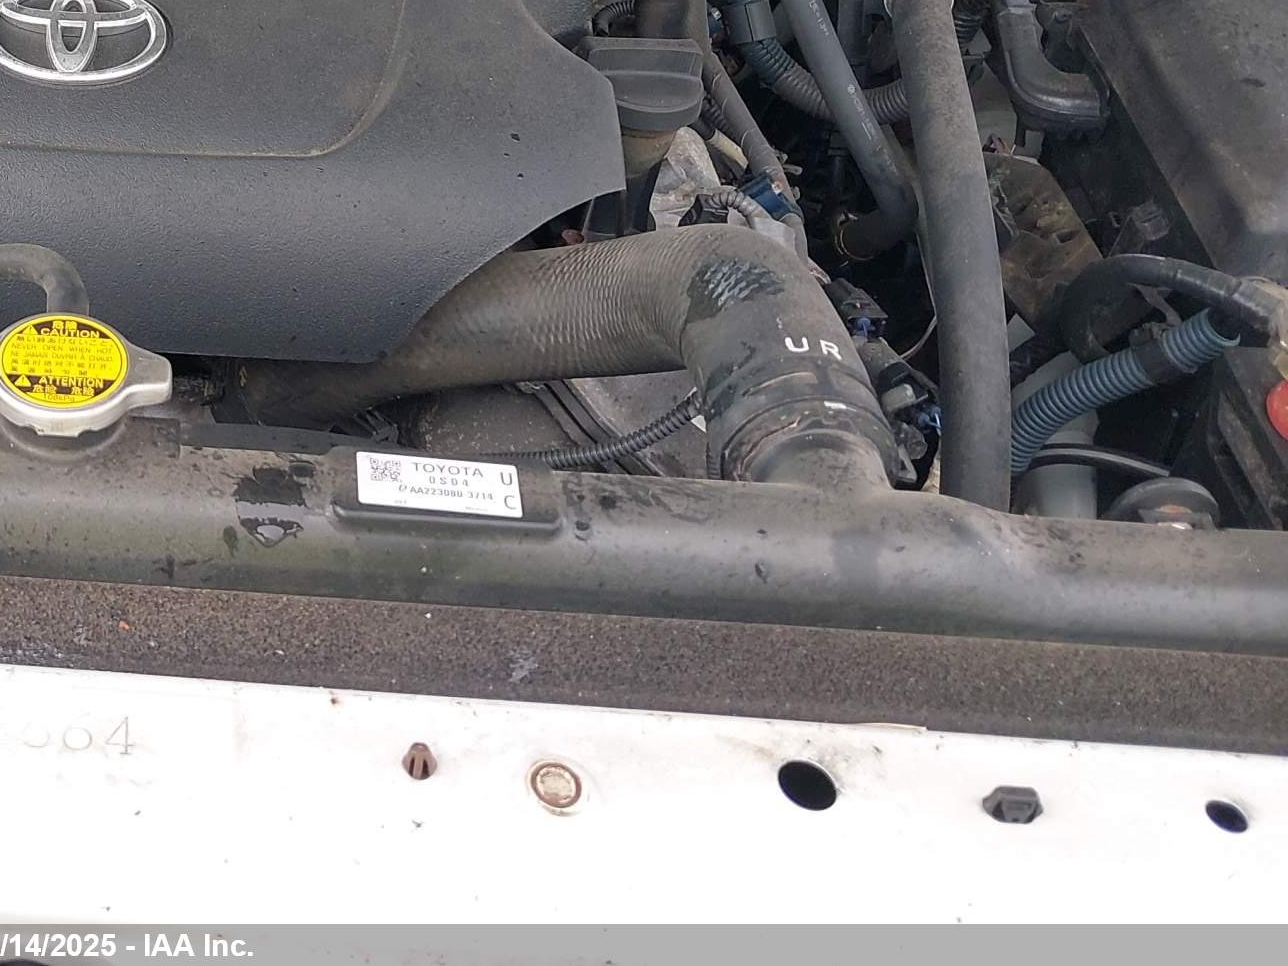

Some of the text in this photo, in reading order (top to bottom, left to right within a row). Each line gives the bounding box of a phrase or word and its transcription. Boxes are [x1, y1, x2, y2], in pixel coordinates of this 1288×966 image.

[40, 327, 100, 339] CAUTION
[69, 346, 91, 354] WHEN
[38, 375, 104, 389] ATTENTION
[411, 462, 484, 478] TOYOTA
[499, 471, 513, 486] U
[504, 495, 517, 510] C
